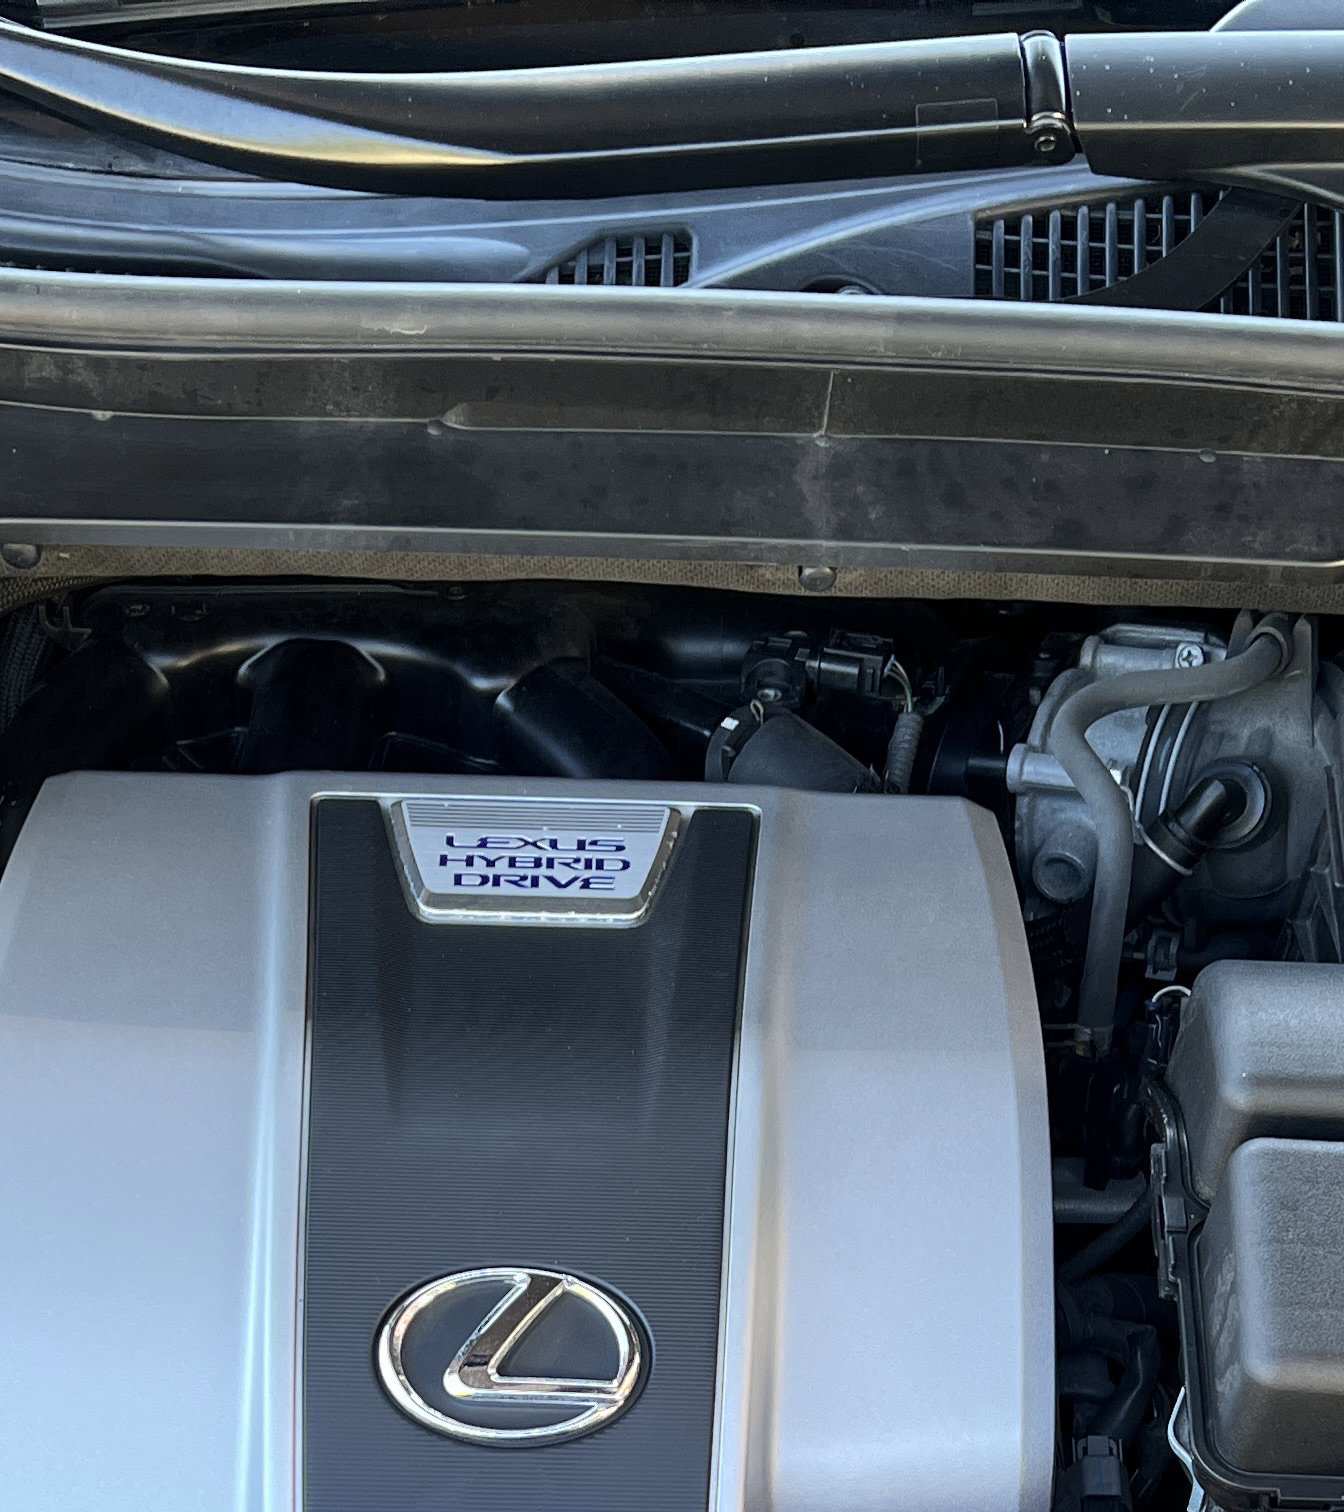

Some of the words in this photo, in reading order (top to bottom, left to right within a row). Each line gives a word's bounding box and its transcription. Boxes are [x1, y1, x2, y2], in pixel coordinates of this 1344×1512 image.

[445, 832, 627, 852] LEXUS
[438, 851, 631, 872] HYBRID
[453, 871, 616, 891] DRIVE
